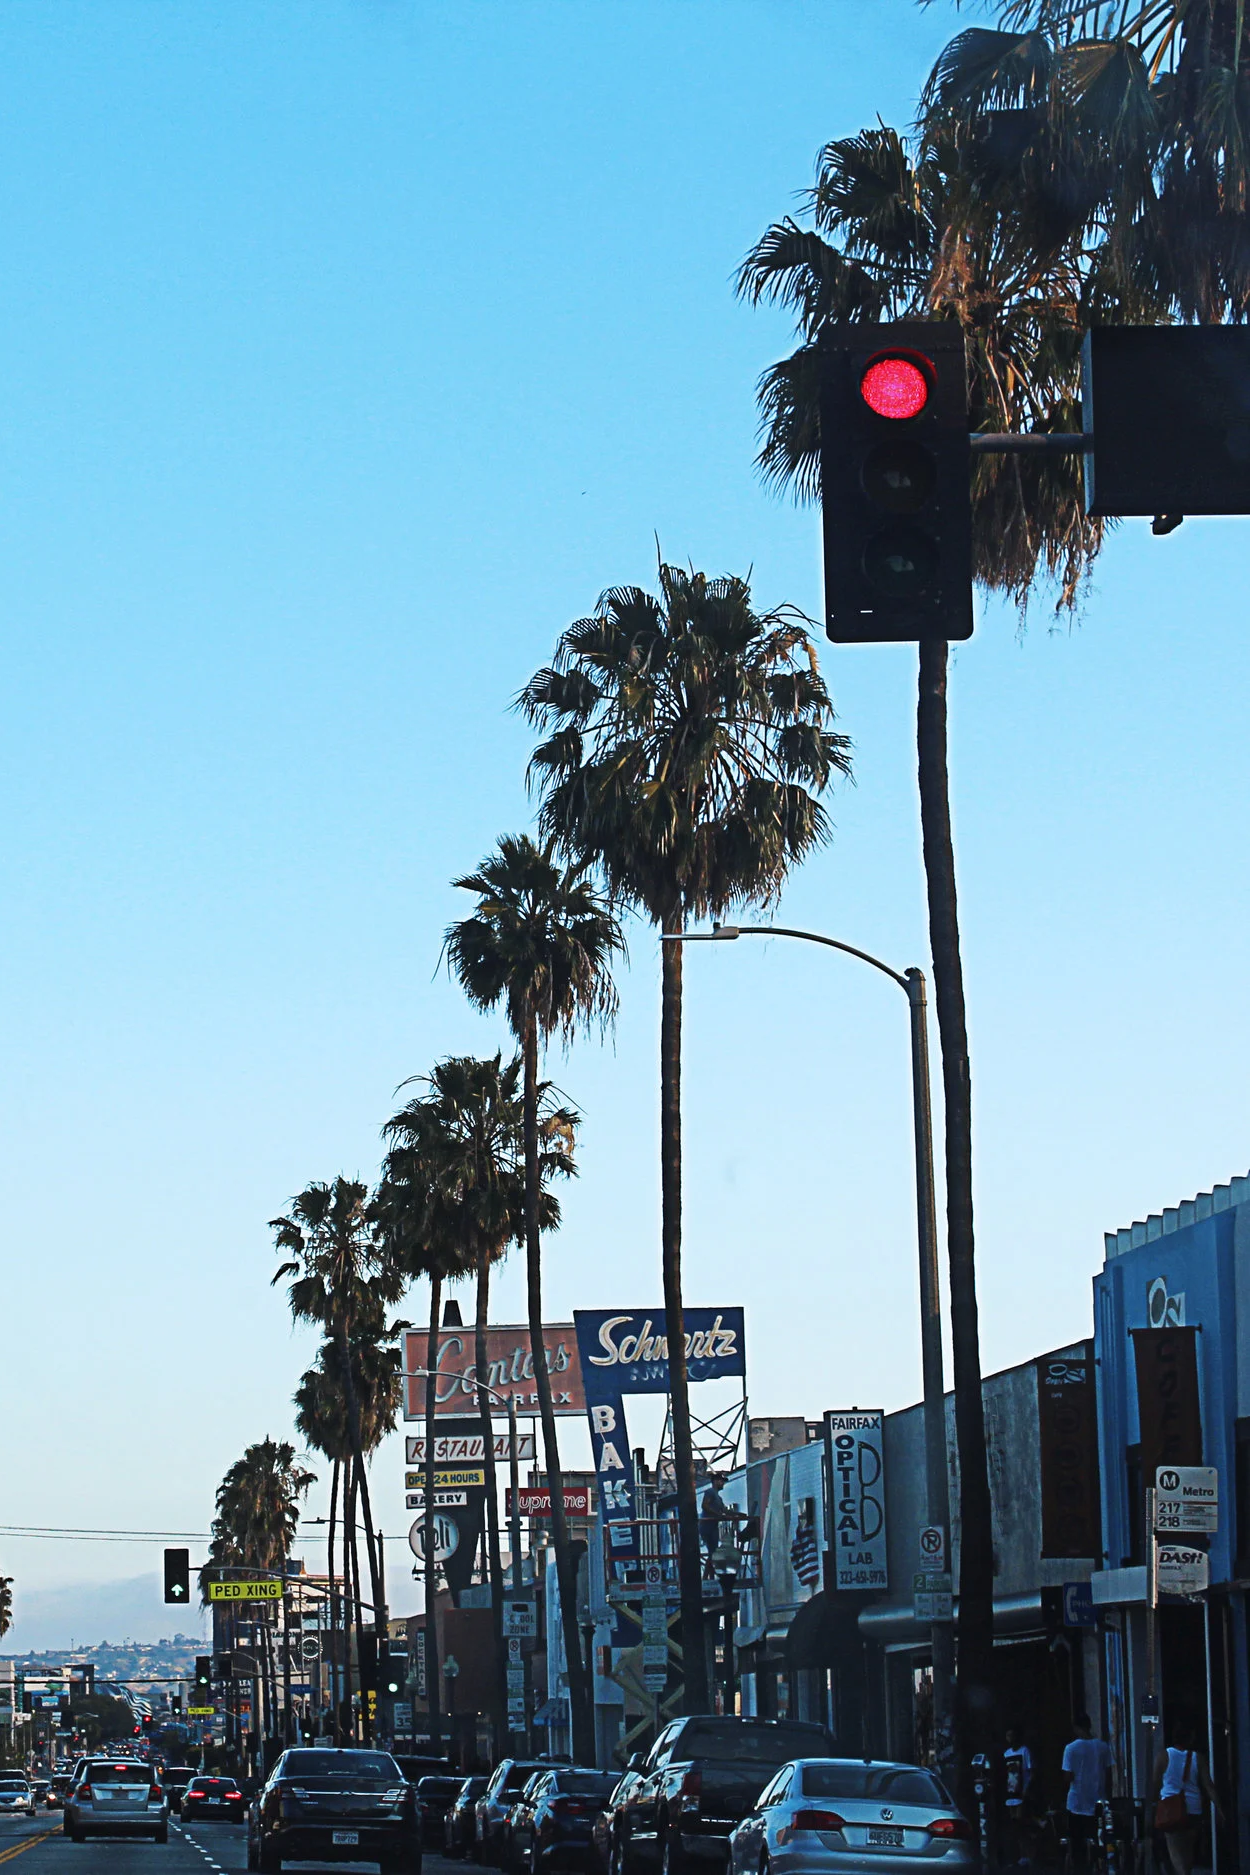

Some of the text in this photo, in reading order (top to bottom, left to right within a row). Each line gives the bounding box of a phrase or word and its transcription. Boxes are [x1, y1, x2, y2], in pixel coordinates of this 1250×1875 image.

[473, 1392, 572, 1406] FAIRFX
[832, 1416, 880, 1431] FAIRFAX
[412, 1437, 530, 1459] RSTAUAT
[408, 1473, 480, 1485] OPE 24 HOURS
[834, 1434, 859, 1547] OPTICAL
[1182, 1486, 1214, 1496] Metro
[1159, 1502, 1181, 1513] 217
[1158, 1516, 1180, 1527] 218
[848, 1552, 873, 1565] LAB
[215, 1584, 277, 1597] PED XING
[509, 1624, 530, 1634] ZONE
[397, 1717, 412, 1727] 35
